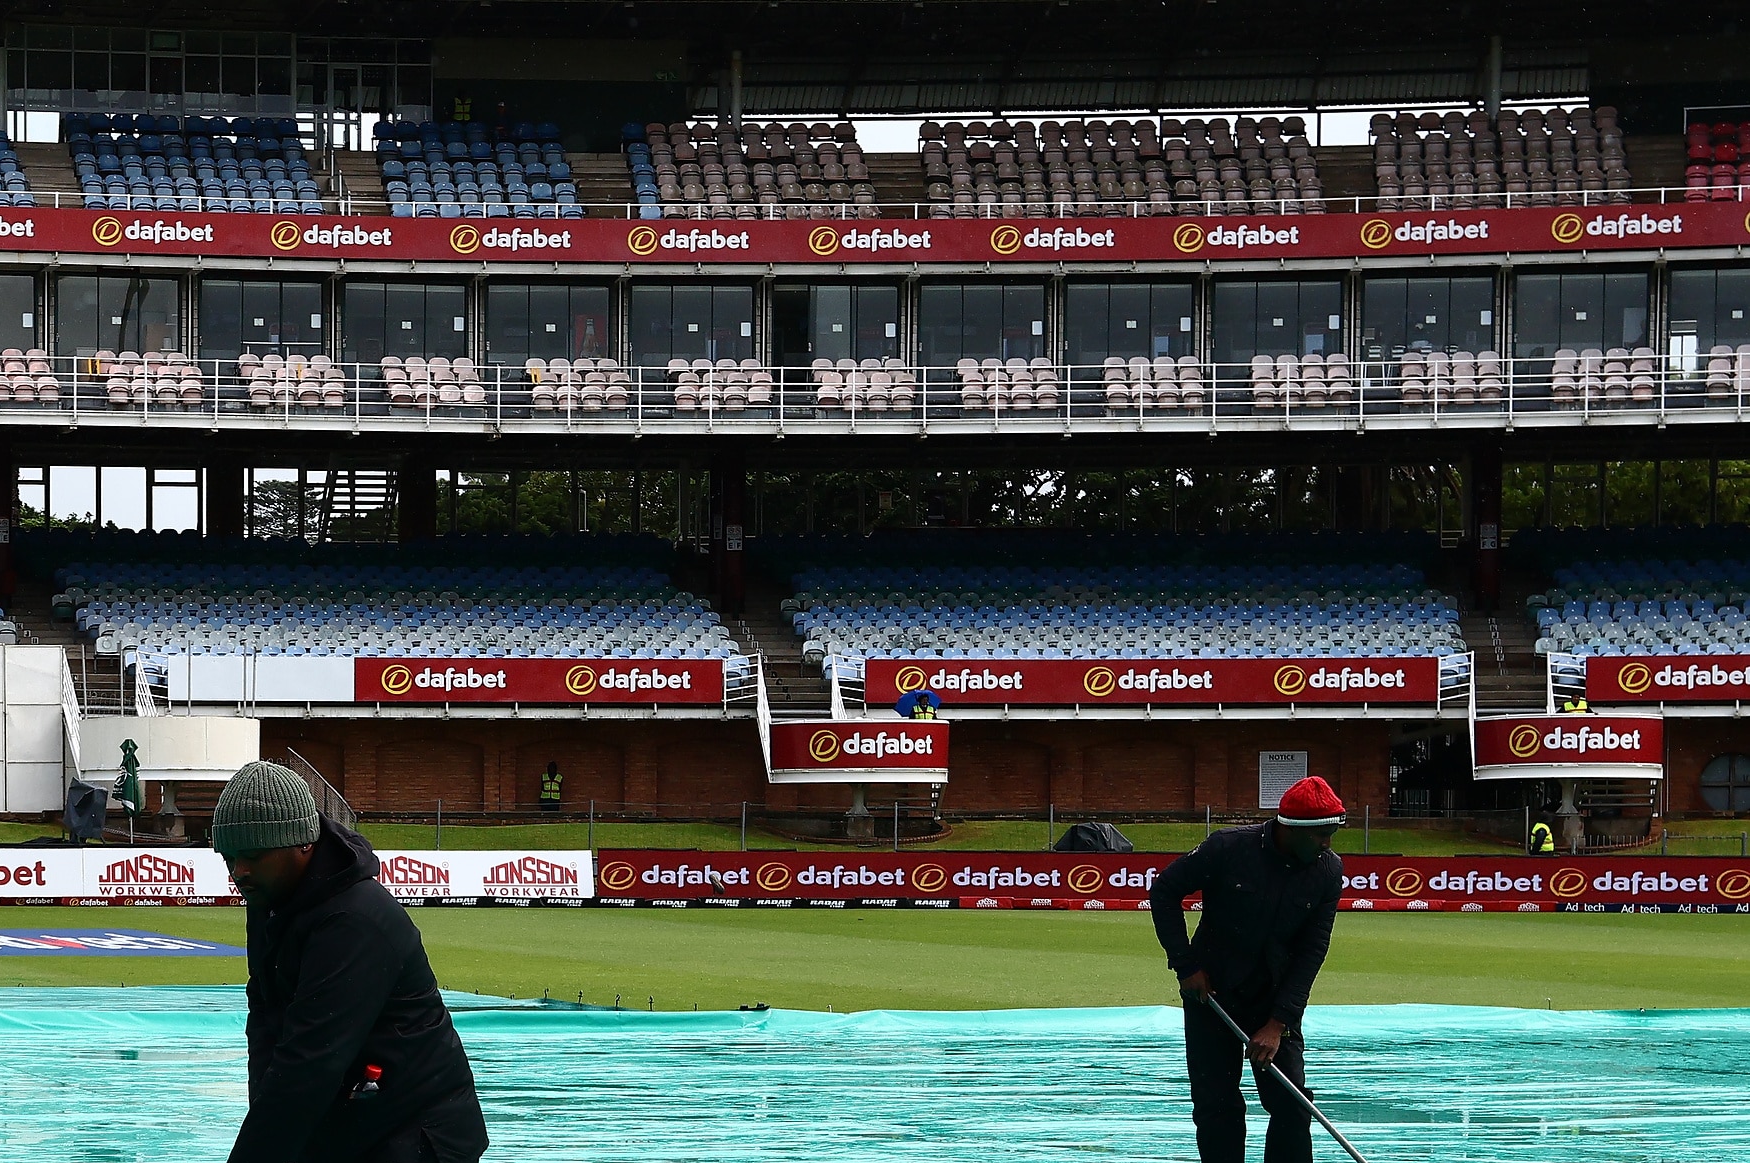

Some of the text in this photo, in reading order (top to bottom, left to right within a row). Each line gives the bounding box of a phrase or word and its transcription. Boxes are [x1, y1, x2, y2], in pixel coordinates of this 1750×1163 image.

[125, 220, 213, 243] dafabet
[304, 225, 391, 248] dafabet
[1207, 225, 1298, 248] dafabet
[1395, 220, 1488, 243] dafabet
[1587, 214, 1681, 238] dafabet
[483, 228, 570, 251] dafabet
[661, 229, 749, 252] dafabet
[842, 229, 930, 252] dafabet
[1024, 228, 1114, 250] dafabet
[415, 668, 505, 691] dafabet
[600, 668, 690, 692] dafabet
[930, 669, 1022, 693] dafabet
[1119, 669, 1212, 692] dafabet
[1309, 668, 1404, 691] dafabet
[843, 732, 932, 758] dafabet
[1544, 727, 1640, 753] dafabet
[99, 854, 194, 882] JONSSON
[378, 856, 449, 883] NSSON
[484, 857, 577, 884] JONSSON
[642, 865, 749, 888] dafabet
[797, 866, 904, 888] dafabet
[953, 867, 1060, 889] dafabet
[99, 887, 194, 896] WORKWEAR
[388, 888, 450, 896] KWEAR
[484, 888, 578, 897] WORKWEAR
[1429, 871, 1542, 894] dafabet
[1594, 871, 1708, 894] dafabet
[26, 897, 53, 905] dafabet
[80, 898, 108, 906] dafabet
[134, 898, 162, 906] dafabet
[187, 896, 215, 905] dafabet
